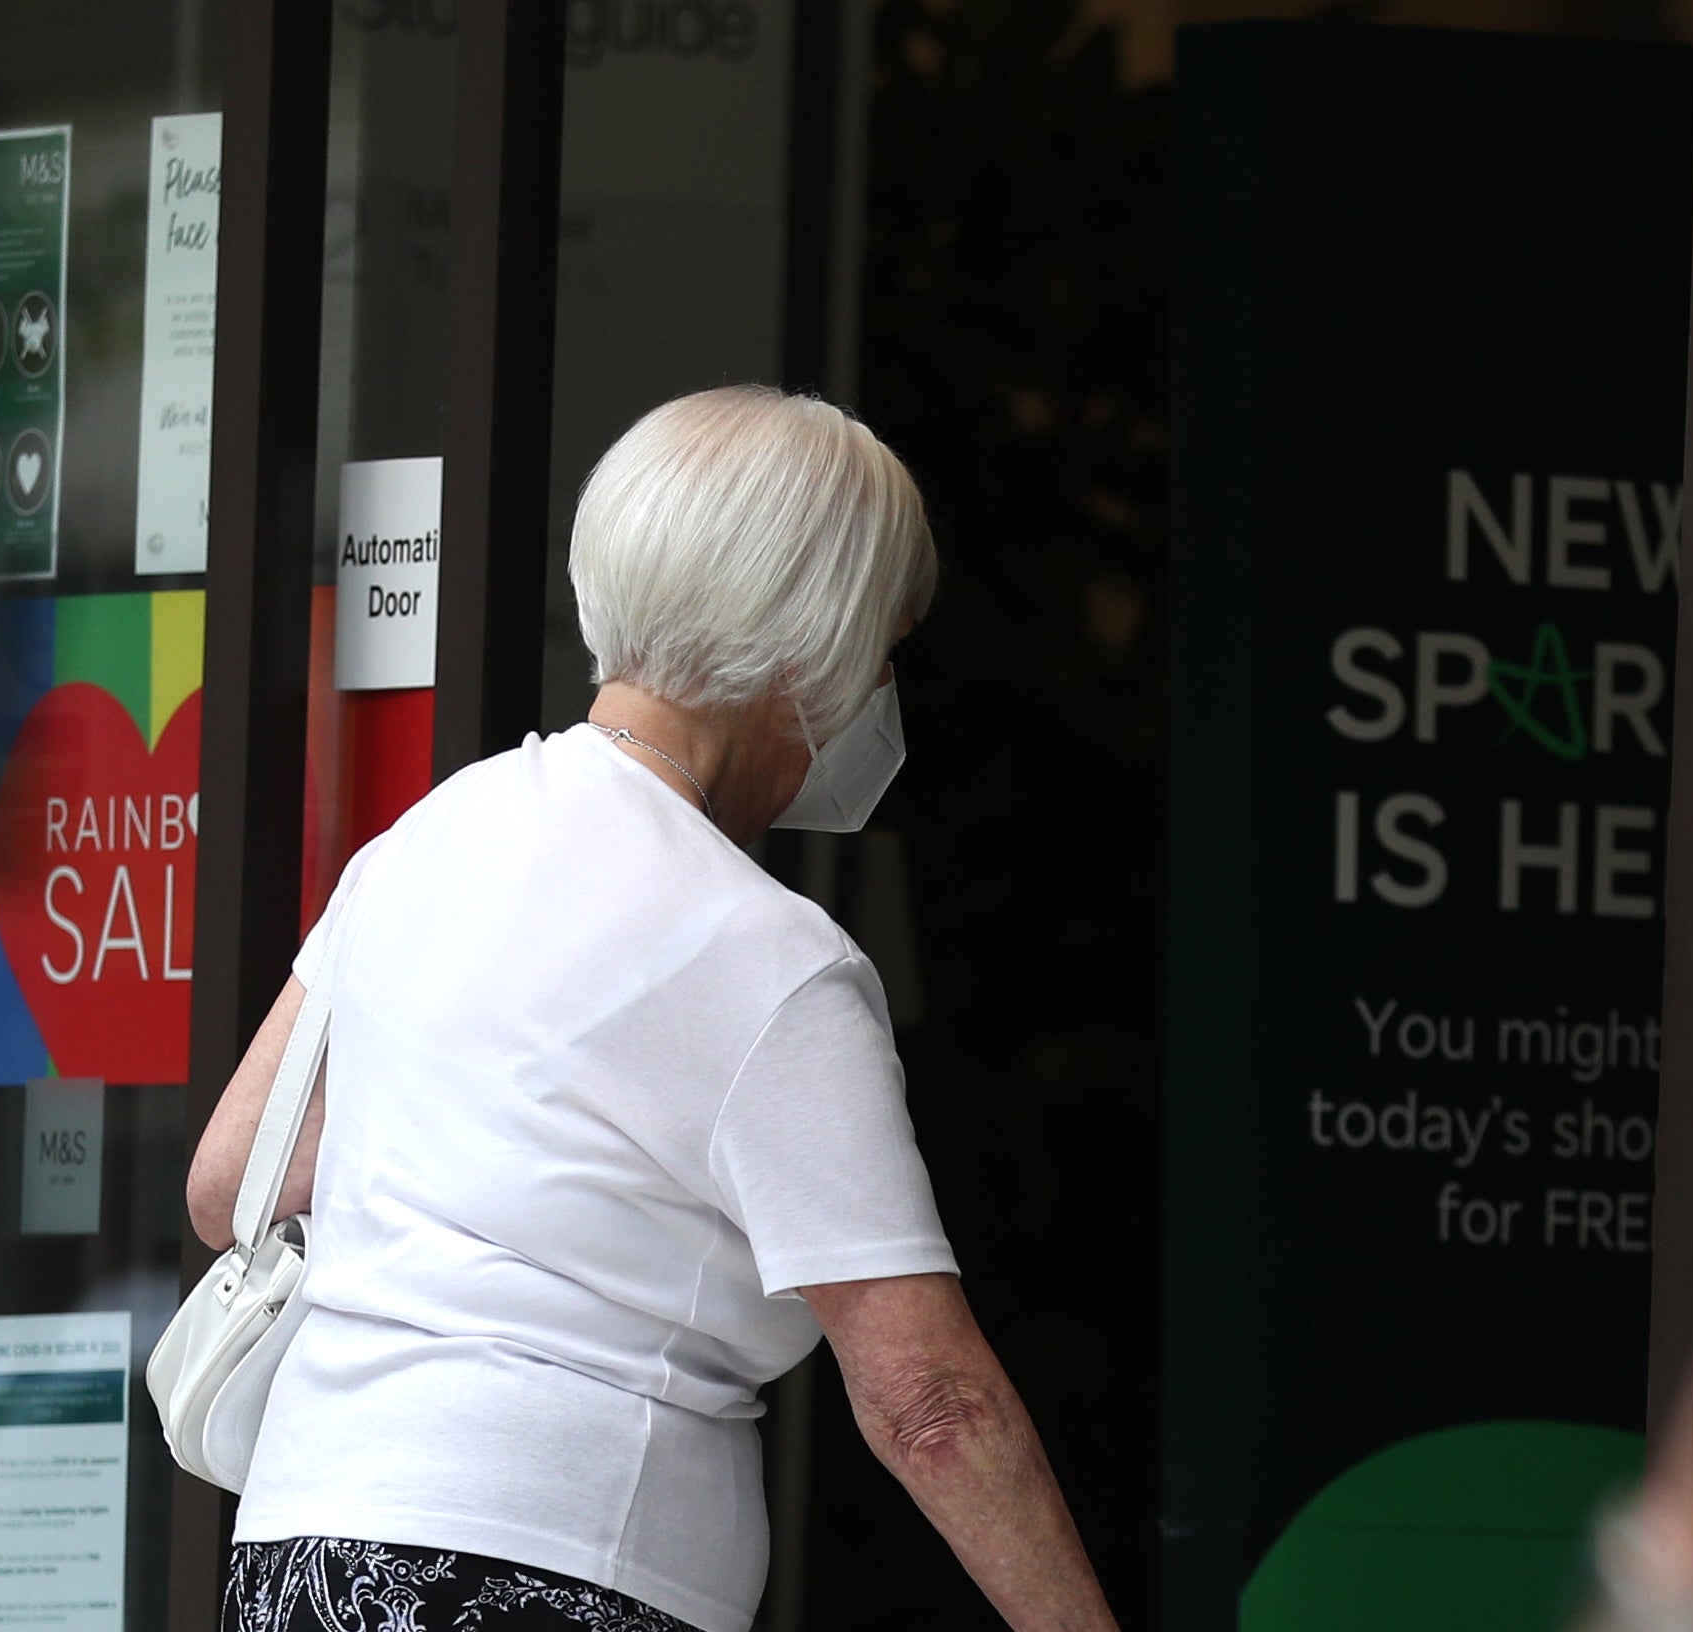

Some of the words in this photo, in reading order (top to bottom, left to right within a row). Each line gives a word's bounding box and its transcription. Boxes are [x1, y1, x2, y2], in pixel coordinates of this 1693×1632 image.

[20, 151, 64, 185] M&S
[164, 156, 220, 204] Pleas
[165, 212, 209, 253] face
[1448, 470, 1684, 594] NEW
[369, 585, 421, 618] Door
[1334, 791, 1449, 908] IS
[1356, 998, 1475, 1060] You
[1498, 1004, 1663, 1082] might
[39, 1129, 87, 1166] M&S
[1308, 1090, 1531, 1168] today's
[1552, 1098, 1652, 1161] sho
[1436, 1182, 1523, 1245] for
[1544, 1189, 1650, 1252] FRE
